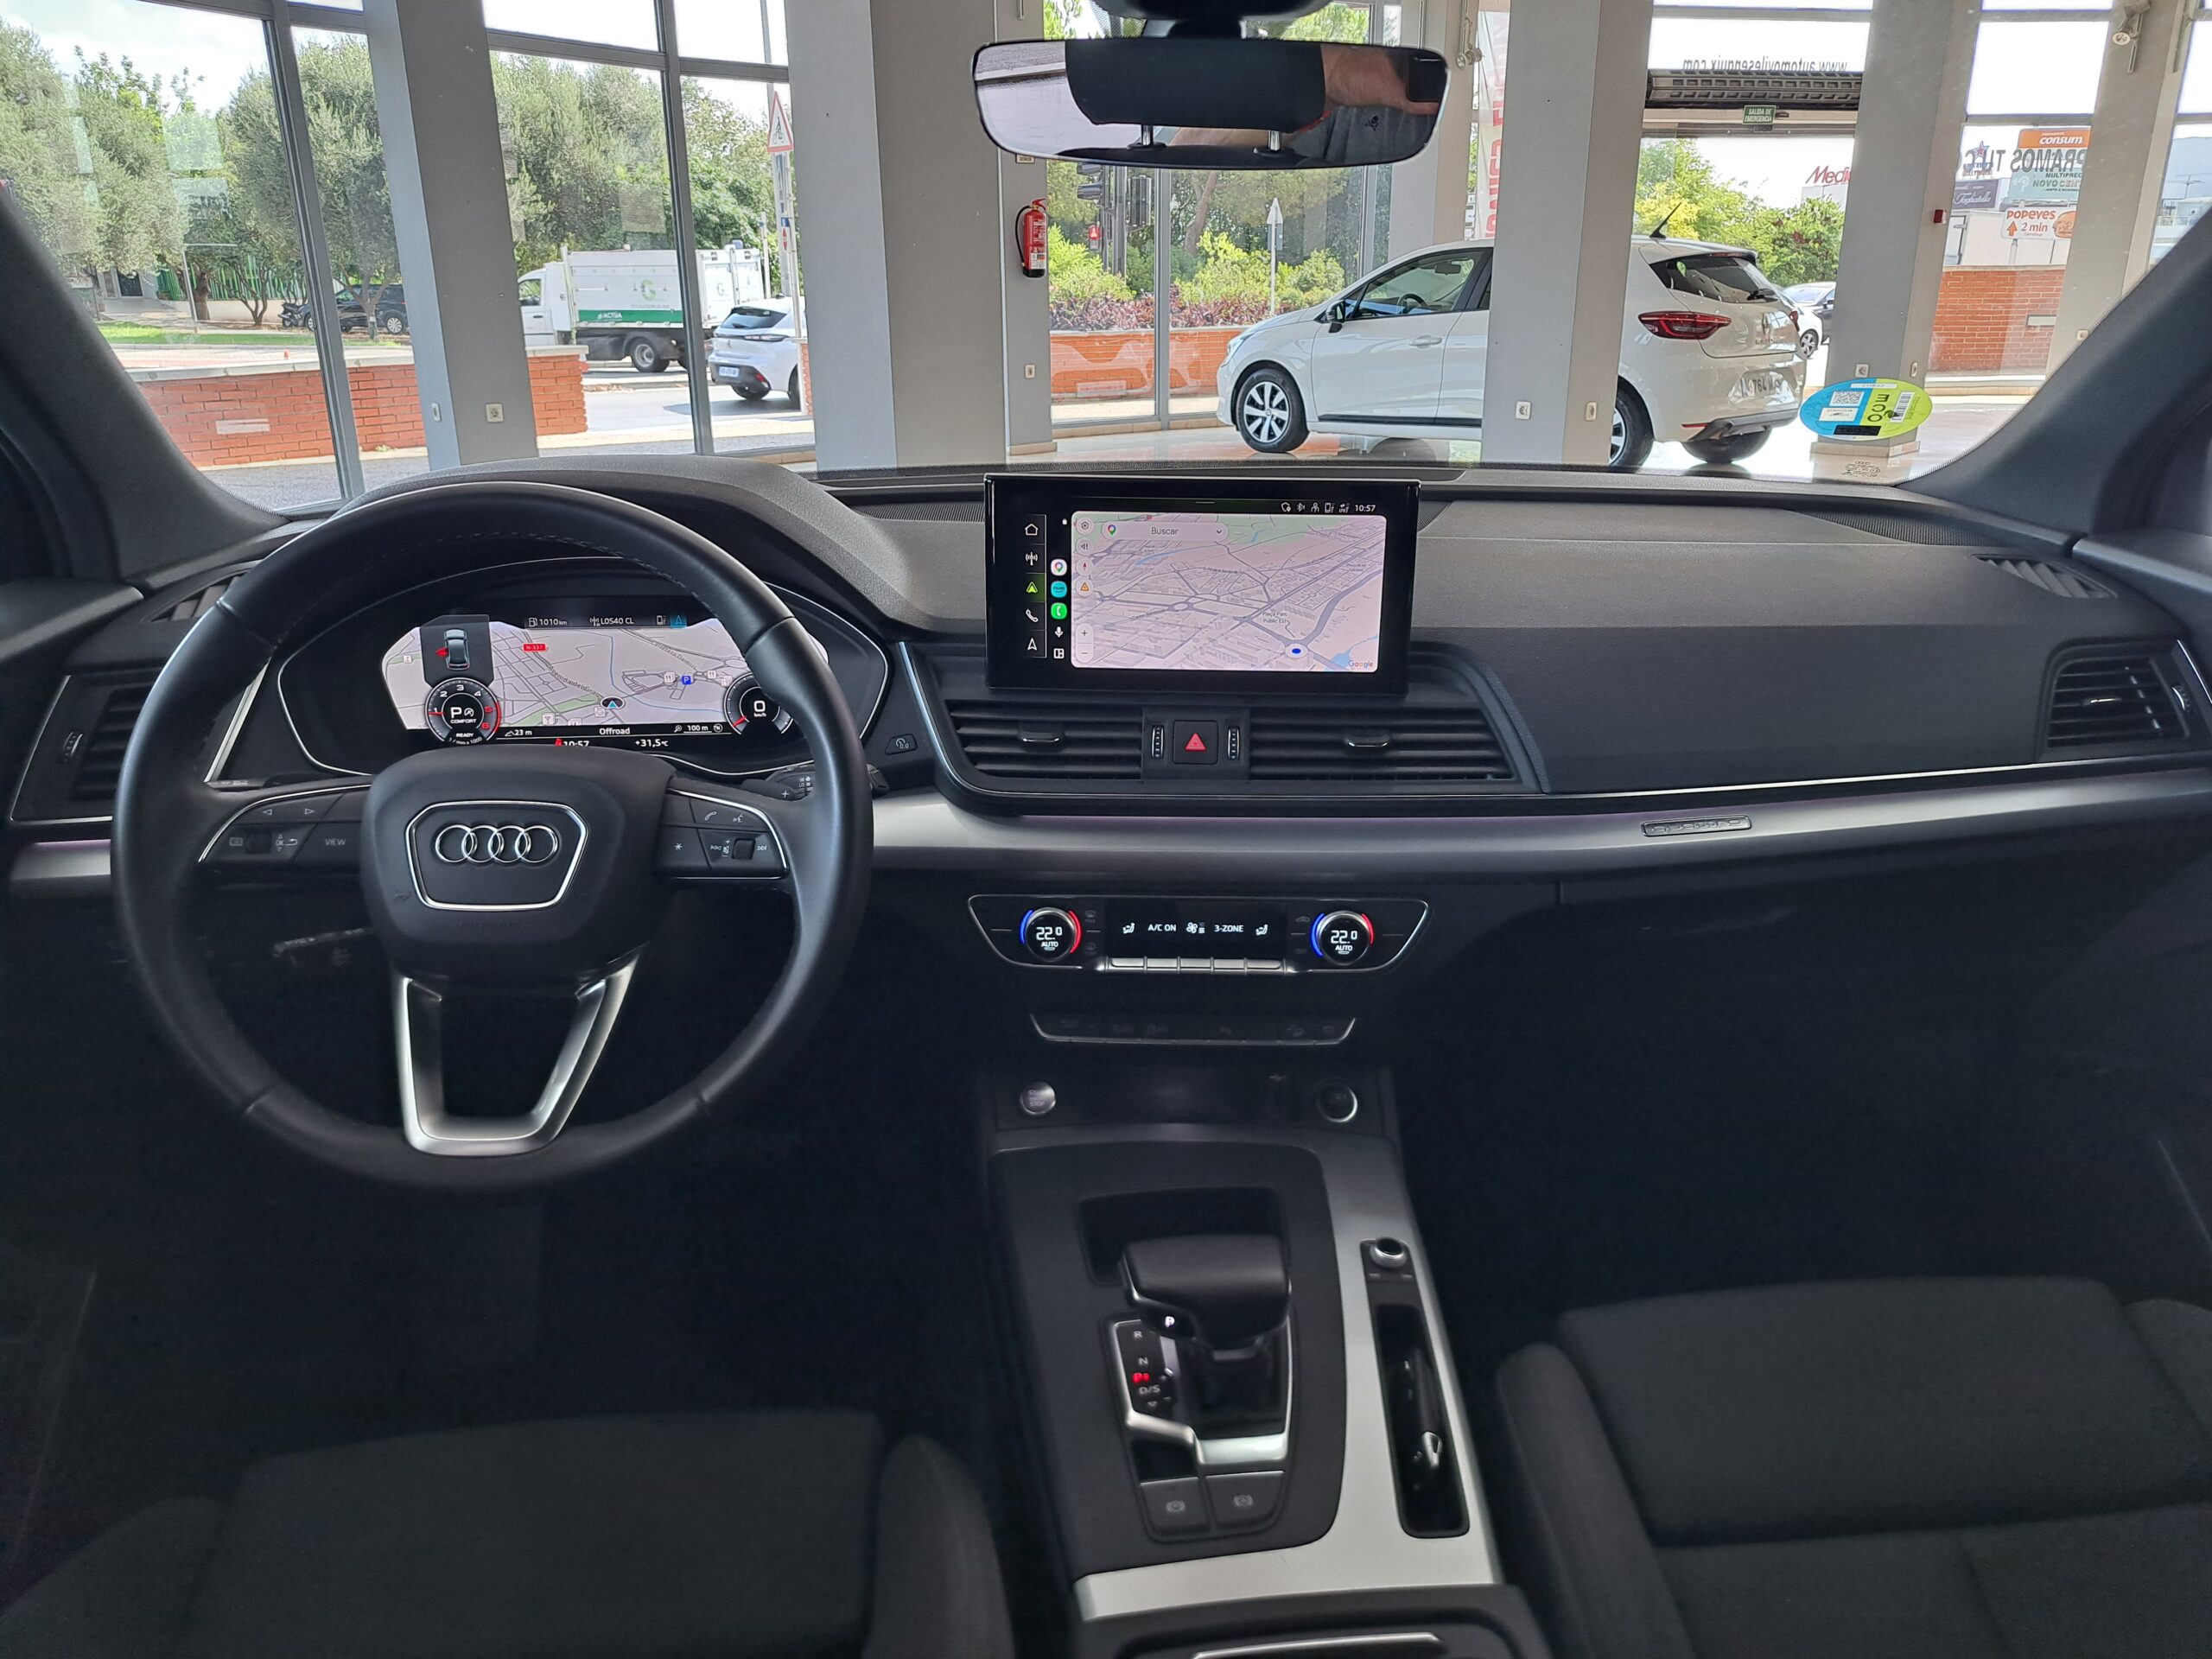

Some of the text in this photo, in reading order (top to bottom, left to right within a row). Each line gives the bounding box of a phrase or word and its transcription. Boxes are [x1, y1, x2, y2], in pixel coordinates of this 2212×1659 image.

[2039, 136, 2083, 145] consum
[2020, 222, 2028, 232] 2
[2029, 221, 2049, 232] min
[1348, 659, 1374, 669] Google
[753, 700, 766, 713] 0
[450, 707, 462, 719] P
[276, 838, 285, 847] OK
[1147, 924, 1177, 932] A/C ON
[1214, 925, 1244, 933] 3-ZONE
[1165, 1316, 1175, 1328] P
[1139, 1357, 1148, 1365] N
[1139, 1384, 1160, 1395] D/S
